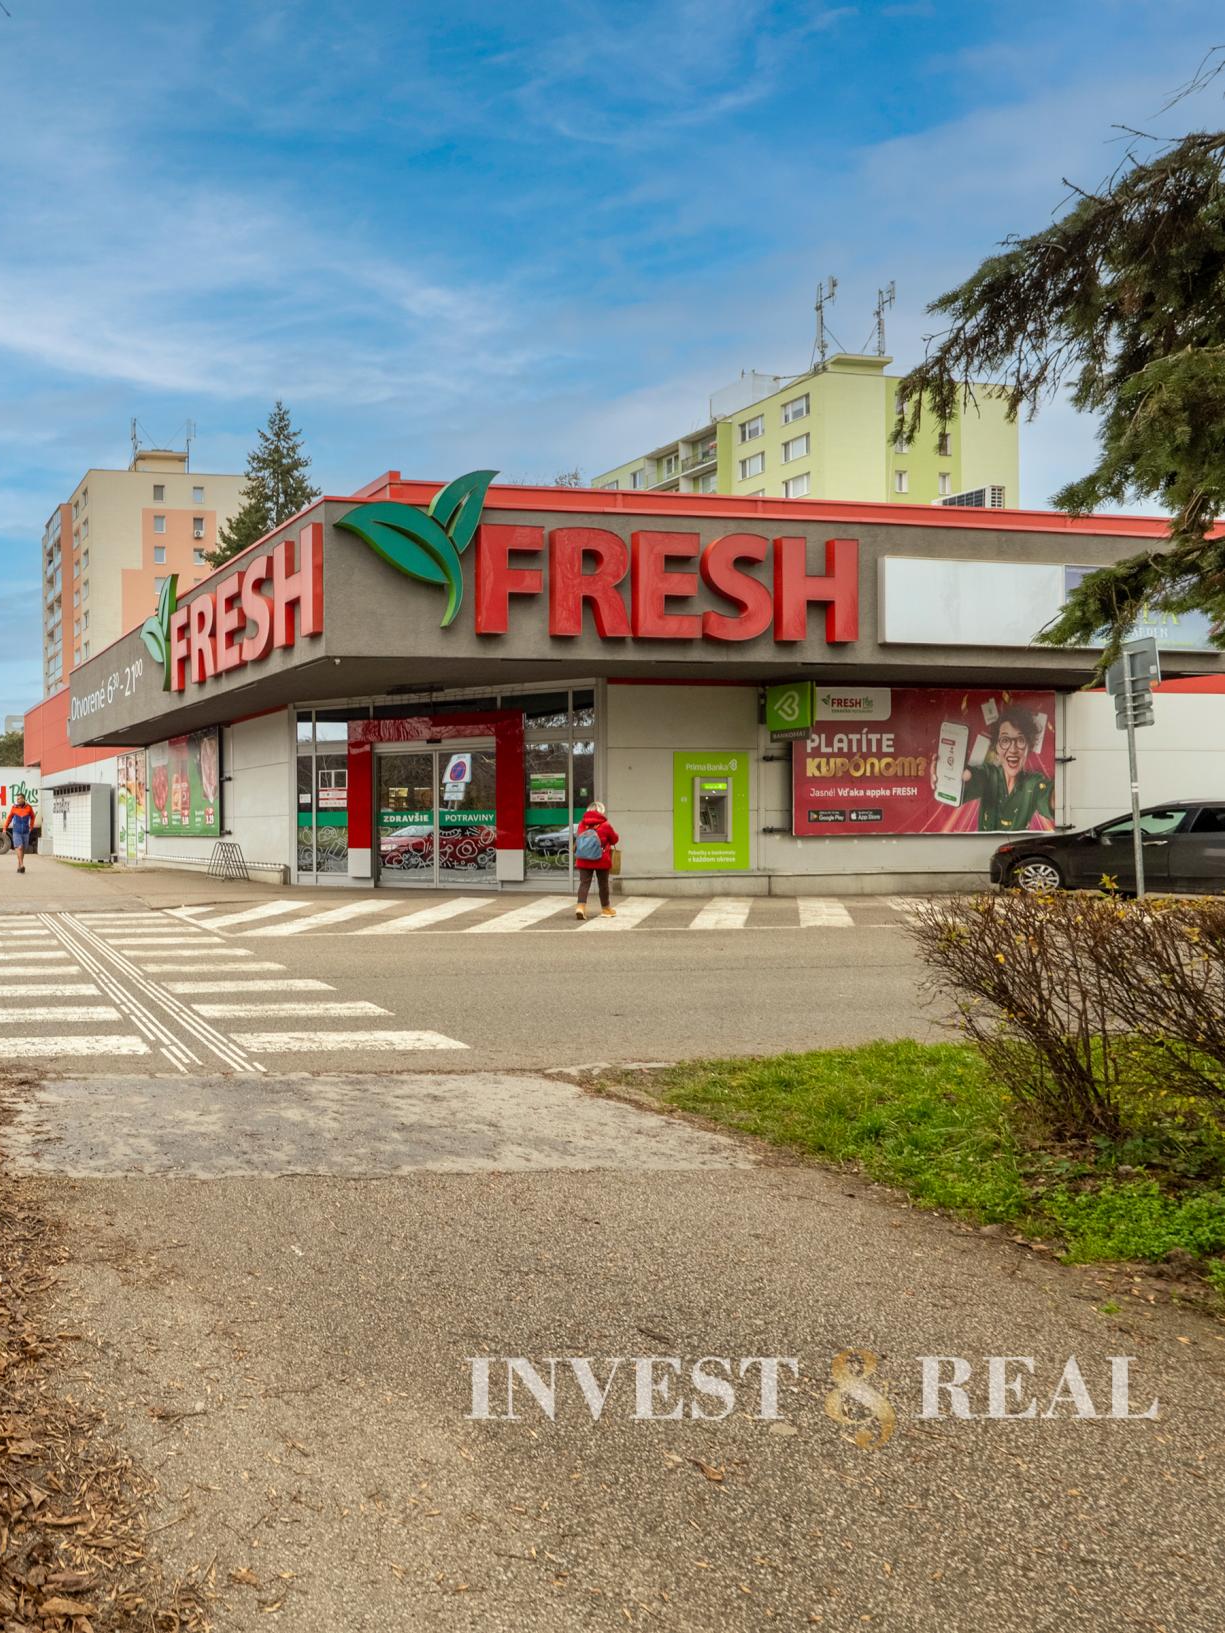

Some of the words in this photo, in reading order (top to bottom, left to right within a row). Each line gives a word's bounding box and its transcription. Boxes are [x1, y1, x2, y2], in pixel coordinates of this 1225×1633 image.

[475, 523, 860, 643] FRESH
[170, 522, 323, 692] FRESH
[71, 680, 105, 720] Otvorené
[831, 698, 862, 708] FRESH
[807, 728, 895, 752] PLATÍTE
[810, 788, 835, 798] Jasné!
[837, 788, 864, 796] Vďaka
[866, 789, 890, 798] appke
[892, 788, 917, 796] FRESH
[383, 812, 429, 823] ZDRAVŠIE
[445, 813, 494, 822] POTRAVINY
